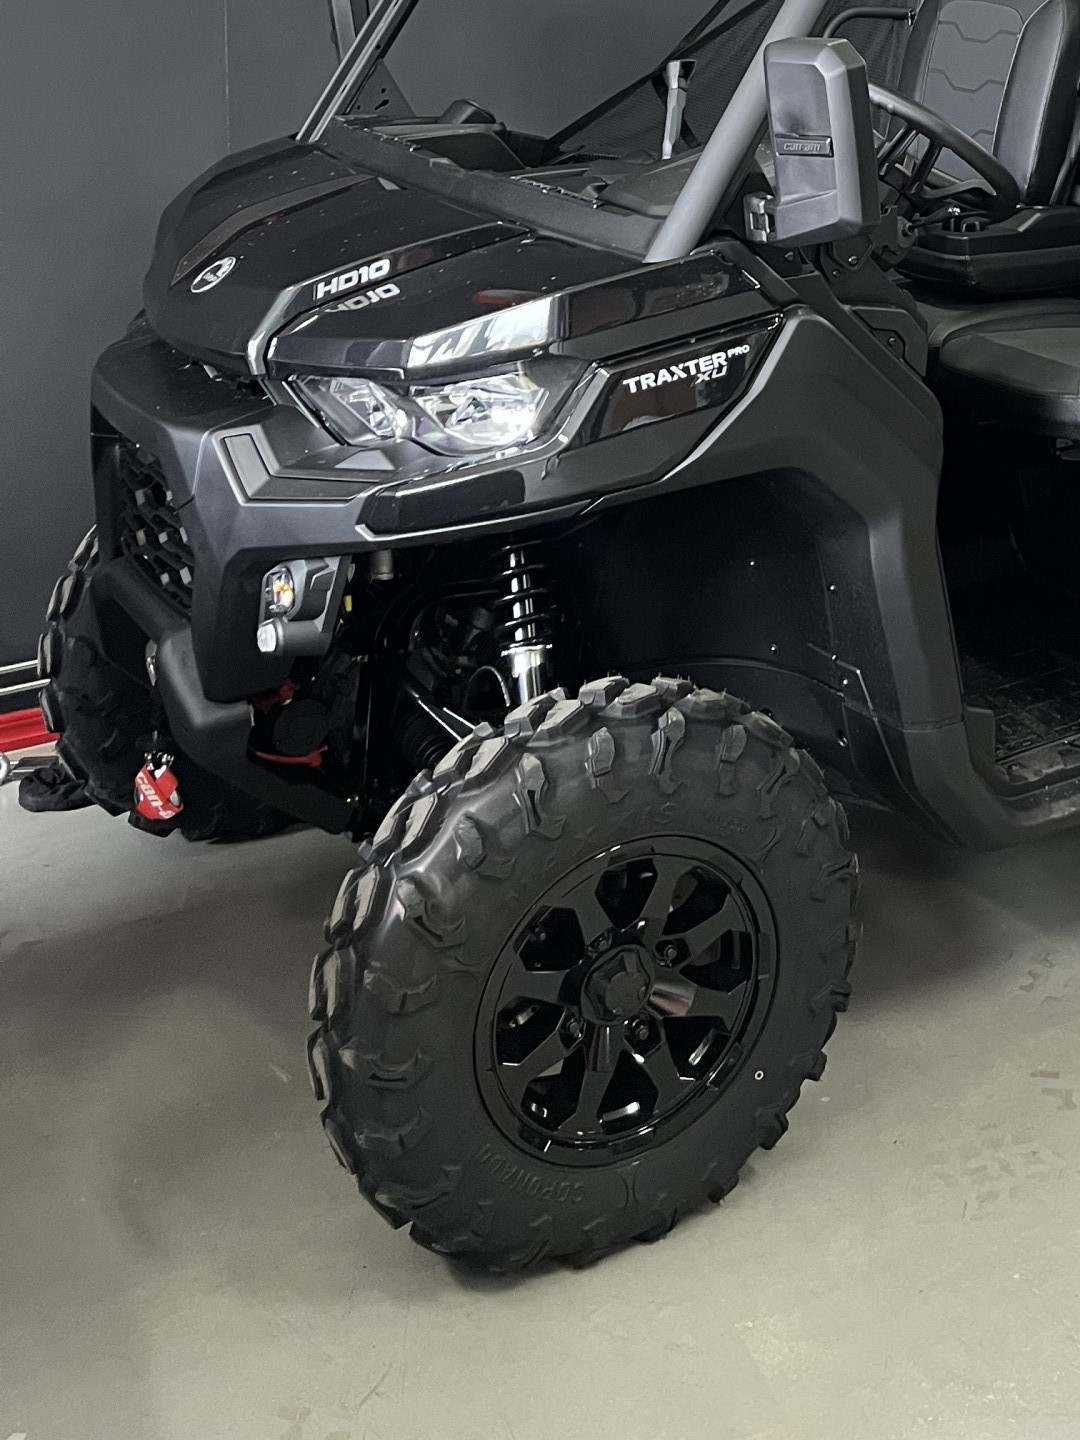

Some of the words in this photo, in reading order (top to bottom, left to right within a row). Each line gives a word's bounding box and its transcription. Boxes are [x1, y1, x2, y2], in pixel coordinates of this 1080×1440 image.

[316, 258, 391, 299] HD10
[623, 351, 728, 394] TRAXTER
[727, 344, 750, 359] PRO
